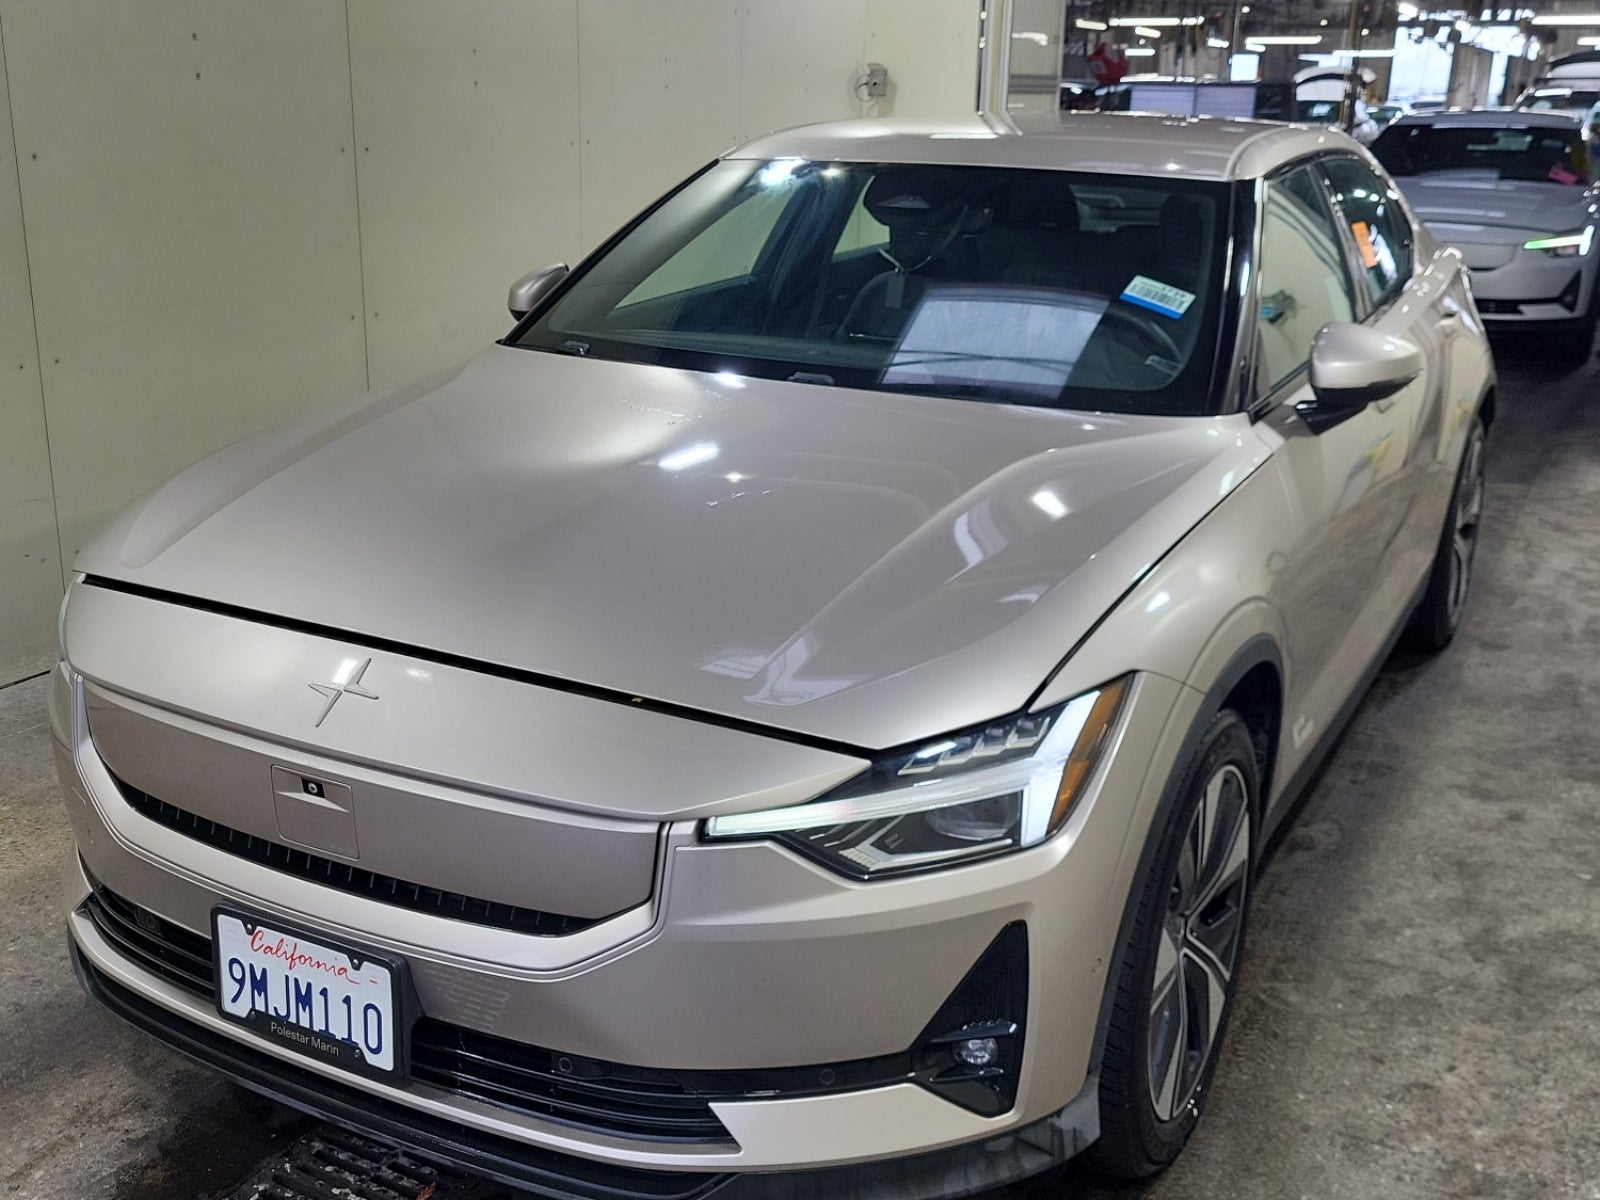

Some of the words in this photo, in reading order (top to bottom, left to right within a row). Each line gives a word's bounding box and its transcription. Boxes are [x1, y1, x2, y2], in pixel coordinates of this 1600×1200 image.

[251, 930, 361, 985] California
[228, 957, 383, 1055] 9MJM110
[270, 1021, 310, 1045] Polestar
[311, 1036, 339, 1056] Marin
